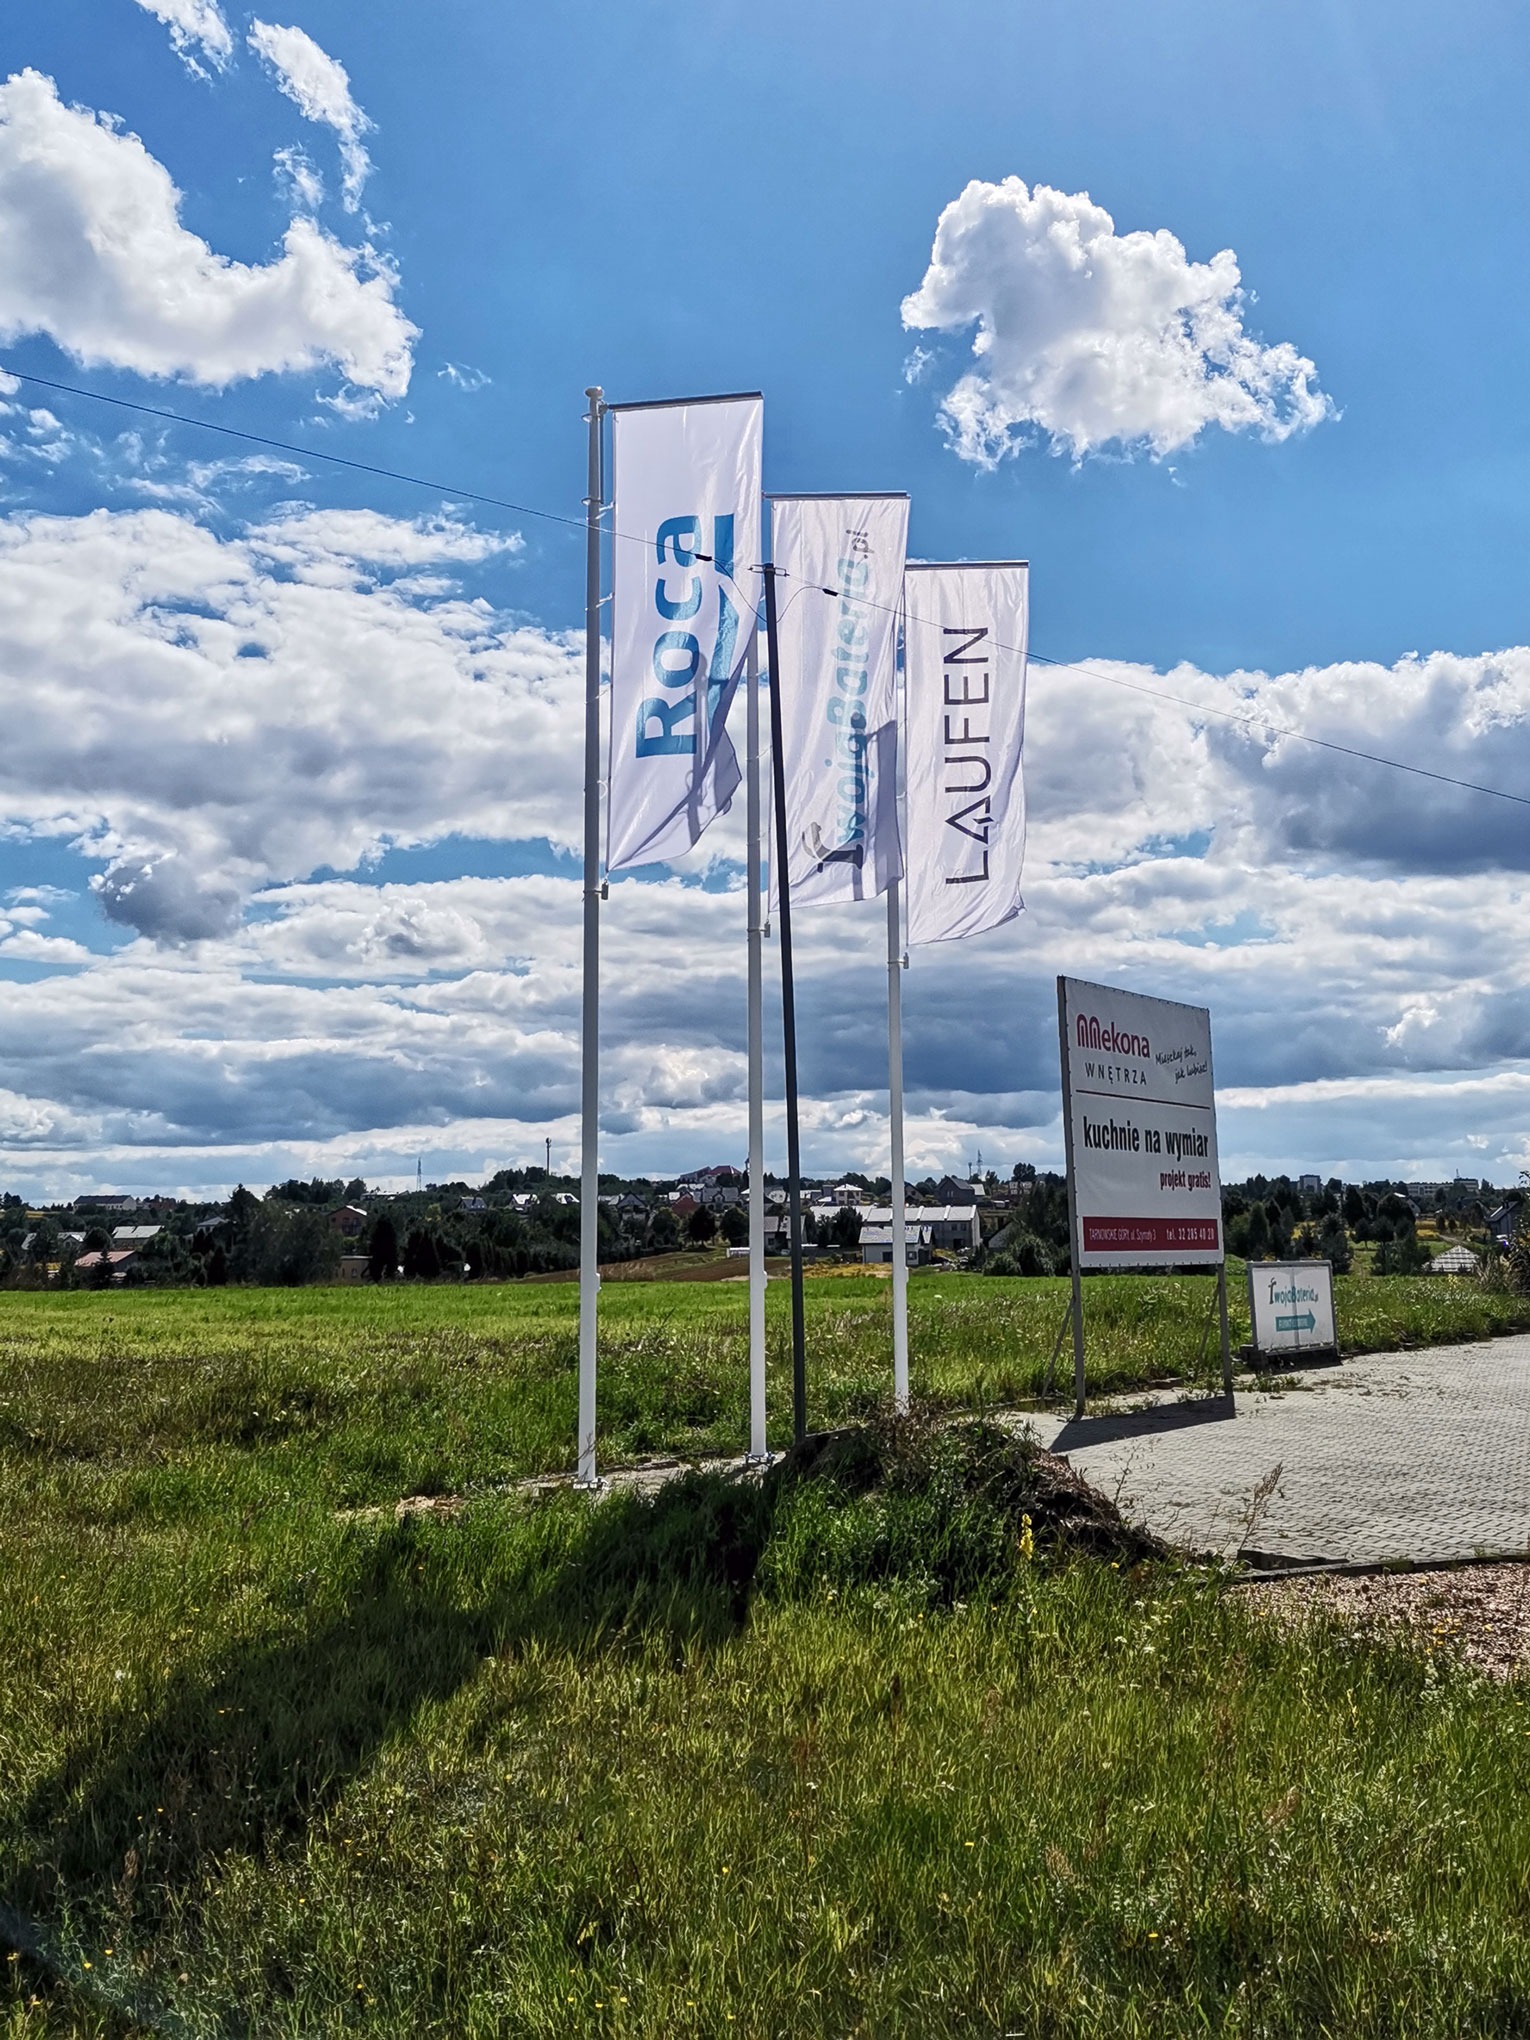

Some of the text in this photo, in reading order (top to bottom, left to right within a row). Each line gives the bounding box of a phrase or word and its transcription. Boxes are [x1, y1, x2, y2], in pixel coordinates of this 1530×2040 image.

[636, 515, 703, 758] Roca
[943, 627, 994, 884] LAUFEN
[1085, 1062, 1147, 1085] WNĘTRZA
[1083, 1116, 1209, 1161] kuchnie na wymiar
[1160, 1169, 1211, 1191] projekt gratis!
[1178, 1227, 1186, 1240] 32
